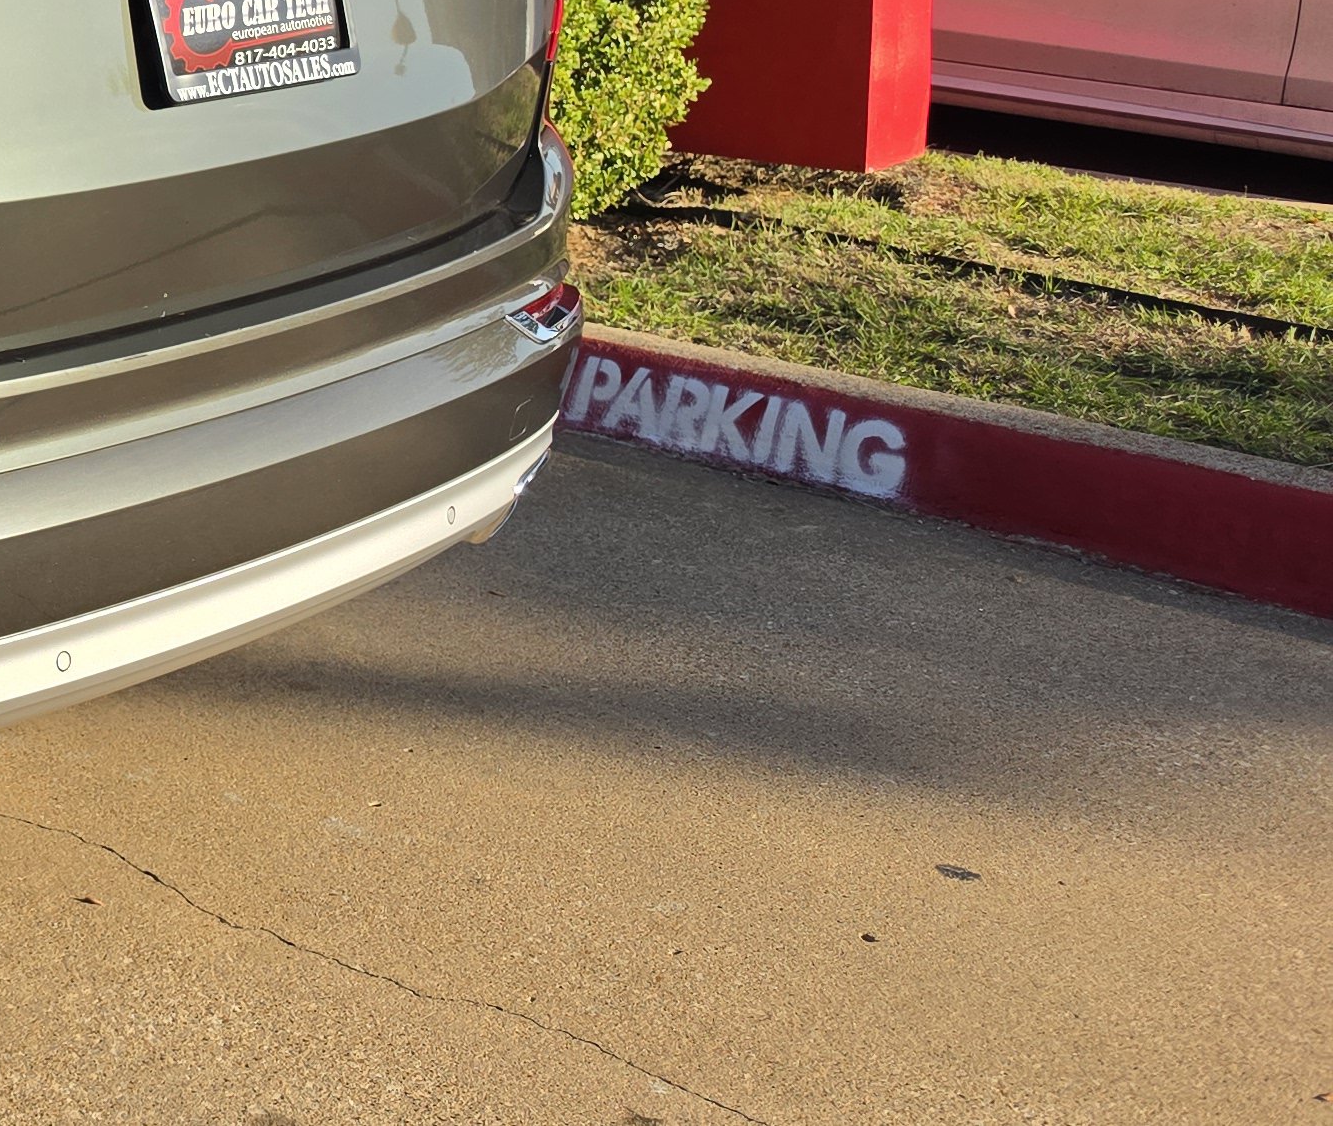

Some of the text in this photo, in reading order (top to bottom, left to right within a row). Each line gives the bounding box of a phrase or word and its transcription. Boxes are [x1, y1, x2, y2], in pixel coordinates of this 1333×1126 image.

[182, 0, 236, 36] EURO
[231, 13, 334, 41] european automotive
[234, 36, 336, 66] 817-404-4033
[176, 53, 356, 102] www.ECTAUTOSALES.com
[563, 355, 907, 500] PARKING
